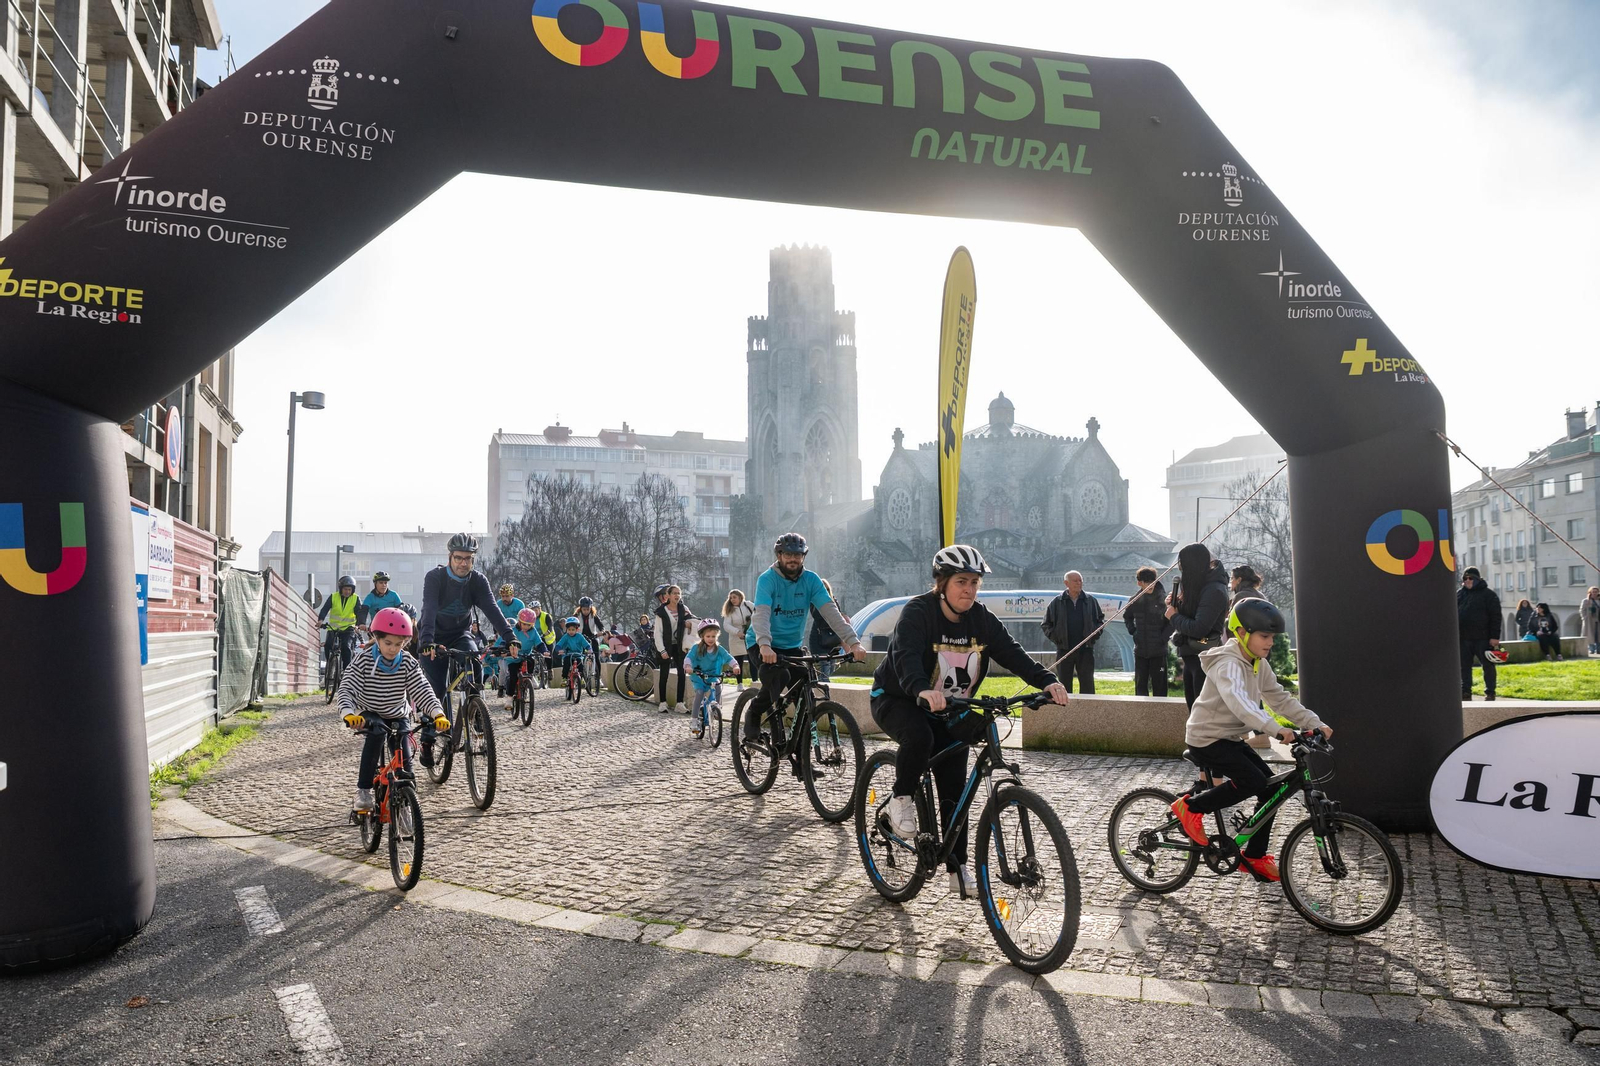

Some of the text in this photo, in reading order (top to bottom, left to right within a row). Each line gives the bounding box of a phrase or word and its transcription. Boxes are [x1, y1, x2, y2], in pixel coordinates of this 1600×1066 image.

[531, 0, 1100, 129] OURENSE
[243, 111, 395, 144] DEPUTACIÓN
[262, 131, 373, 161] OURENSE
[911, 127, 1093, 174] NATURAL
[128, 184, 227, 213] inorde
[126, 216, 287, 249] turismo Ourense
[1178, 211, 1279, 226] DEPUTACIÓN
[1192, 229, 1270, 241] OURENSE
[1288, 280, 1342, 297] inorde
[36, 300, 66, 316] La
[1287, 306, 1334, 319] turismo
[1395, 373, 1408, 382] La
[1456, 762, 1550, 812] La
